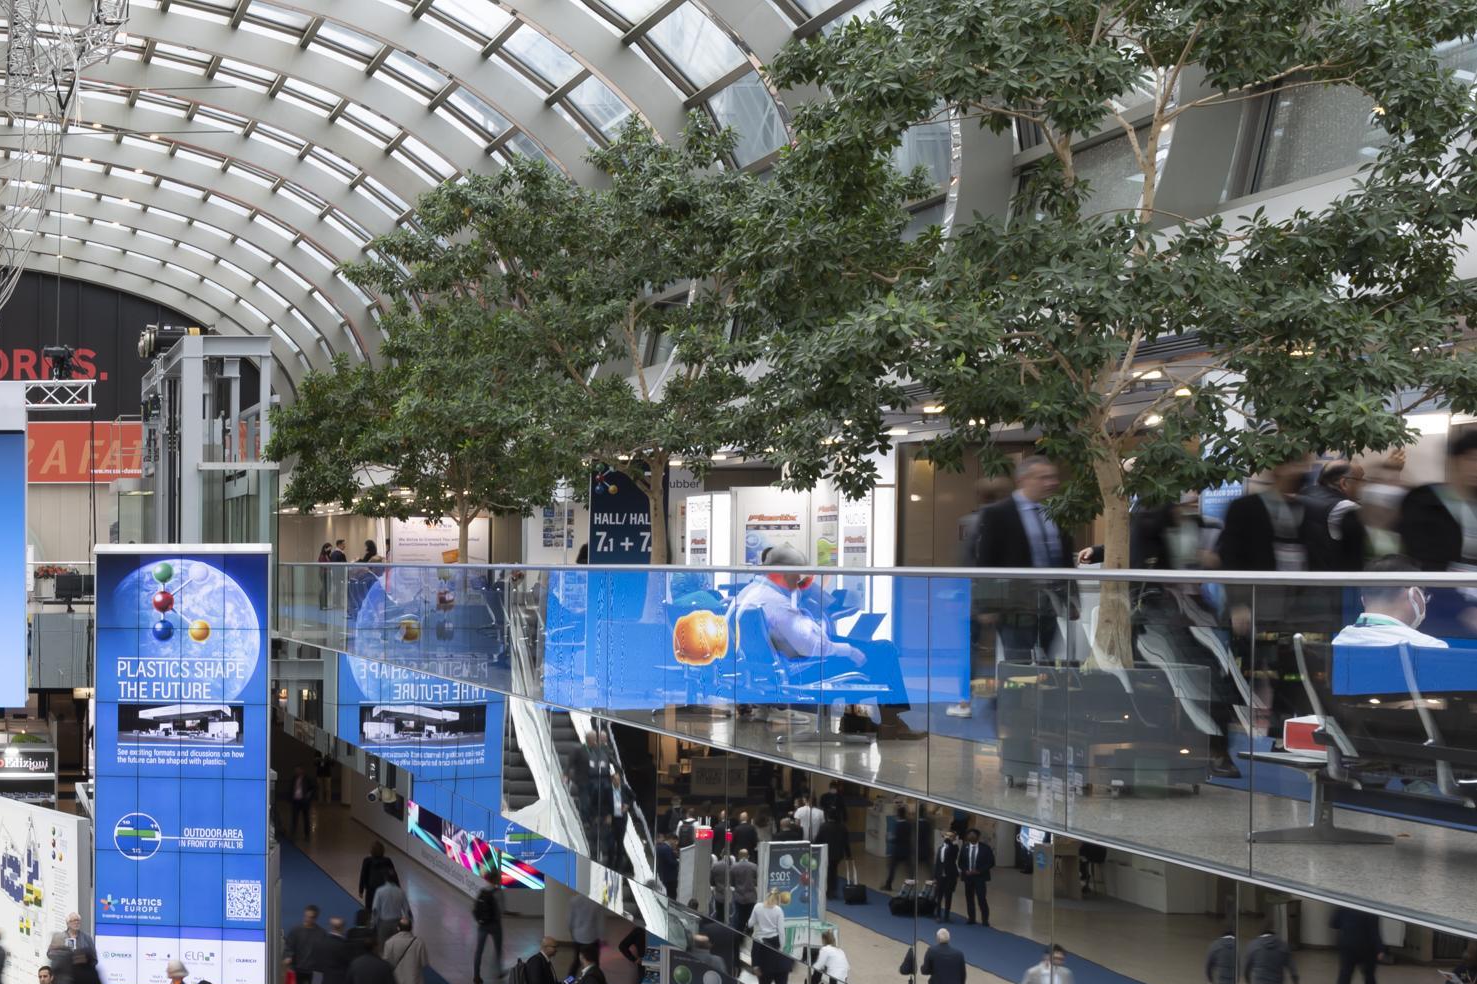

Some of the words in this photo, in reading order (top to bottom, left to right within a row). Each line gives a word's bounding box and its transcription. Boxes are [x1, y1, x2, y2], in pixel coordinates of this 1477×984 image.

[669, 480, 701, 489] ubber
[629, 512, 652, 525] HAL
[639, 532, 652, 553] 7.
[117, 660, 190, 679] PLASTICS
[194, 661, 245, 679] SHAPE
[118, 681, 148, 699] THE
[152, 682, 212, 700] FUTURE
[117, 748, 129, 756] See
[154, 749, 175, 757] formats
[187, 840, 208, 848] FRONT
[209, 840, 218, 848] OF
[120, 897, 162, 907] PLASTICS
[124, 905, 159, 913] EUROPE
